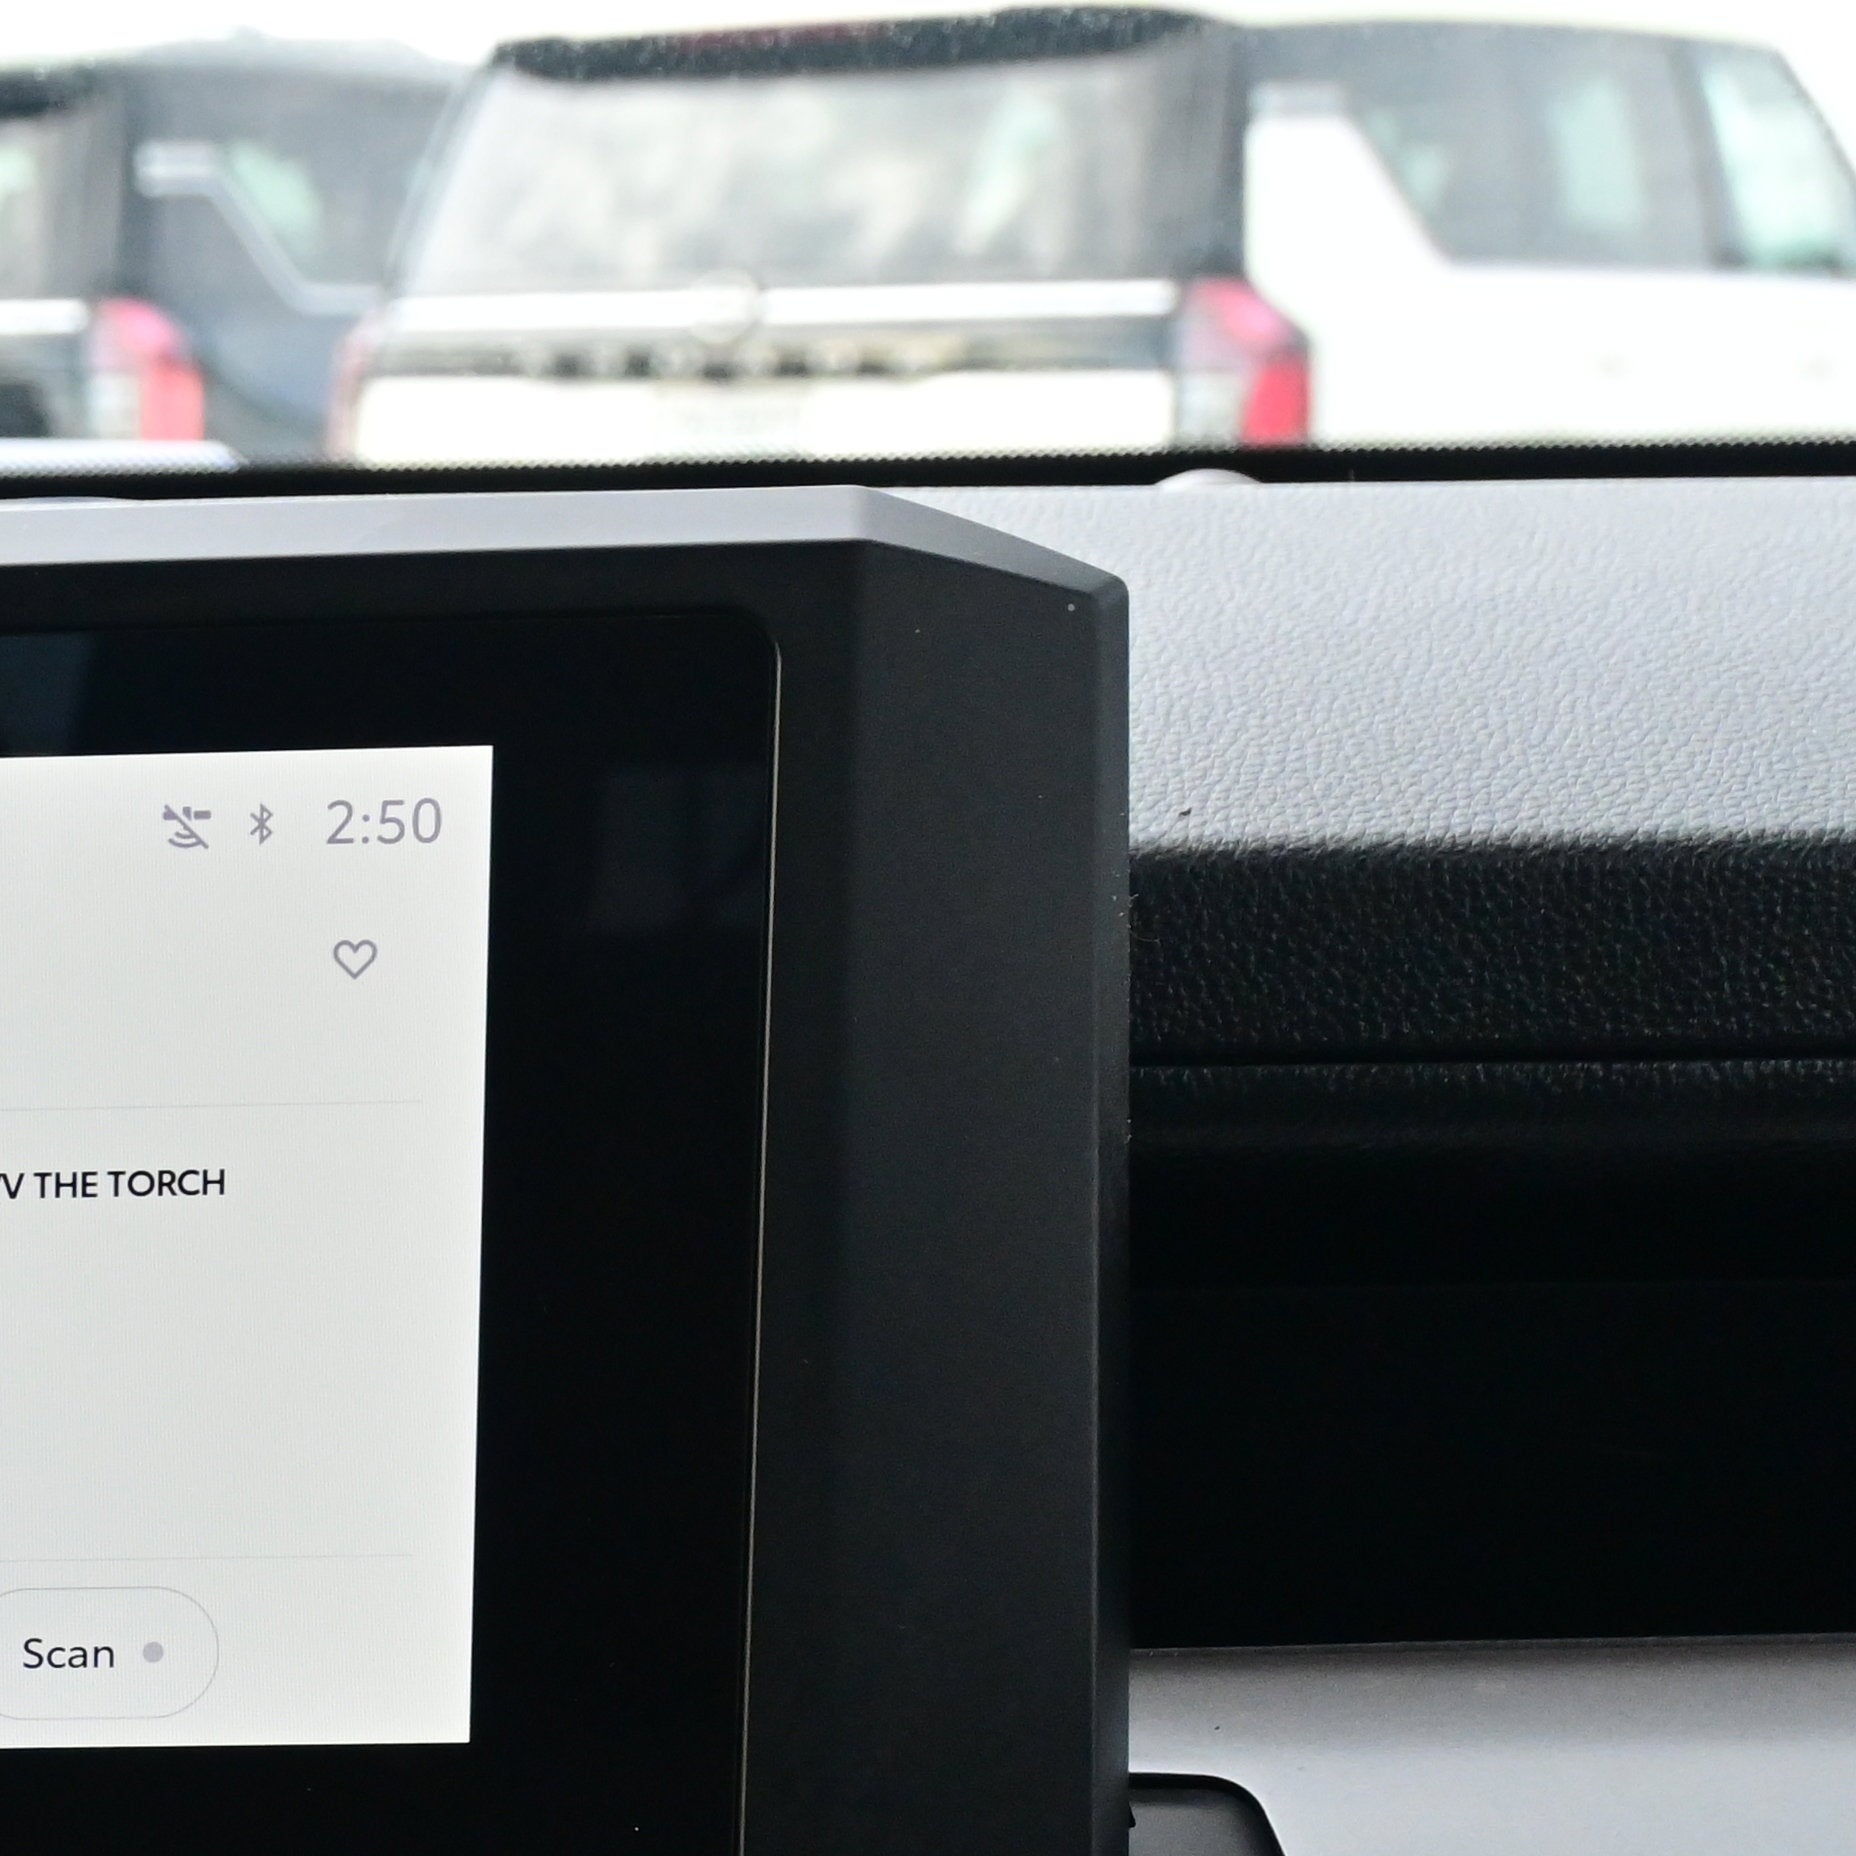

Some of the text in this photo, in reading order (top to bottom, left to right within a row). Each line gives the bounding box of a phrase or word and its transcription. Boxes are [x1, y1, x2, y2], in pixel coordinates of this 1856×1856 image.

[326, 798, 441, 844] 2:50
[34, 1172, 97, 1198] THE
[107, 1169, 225, 1197] TORCH
[23, 1638, 114, 1669] Scan
